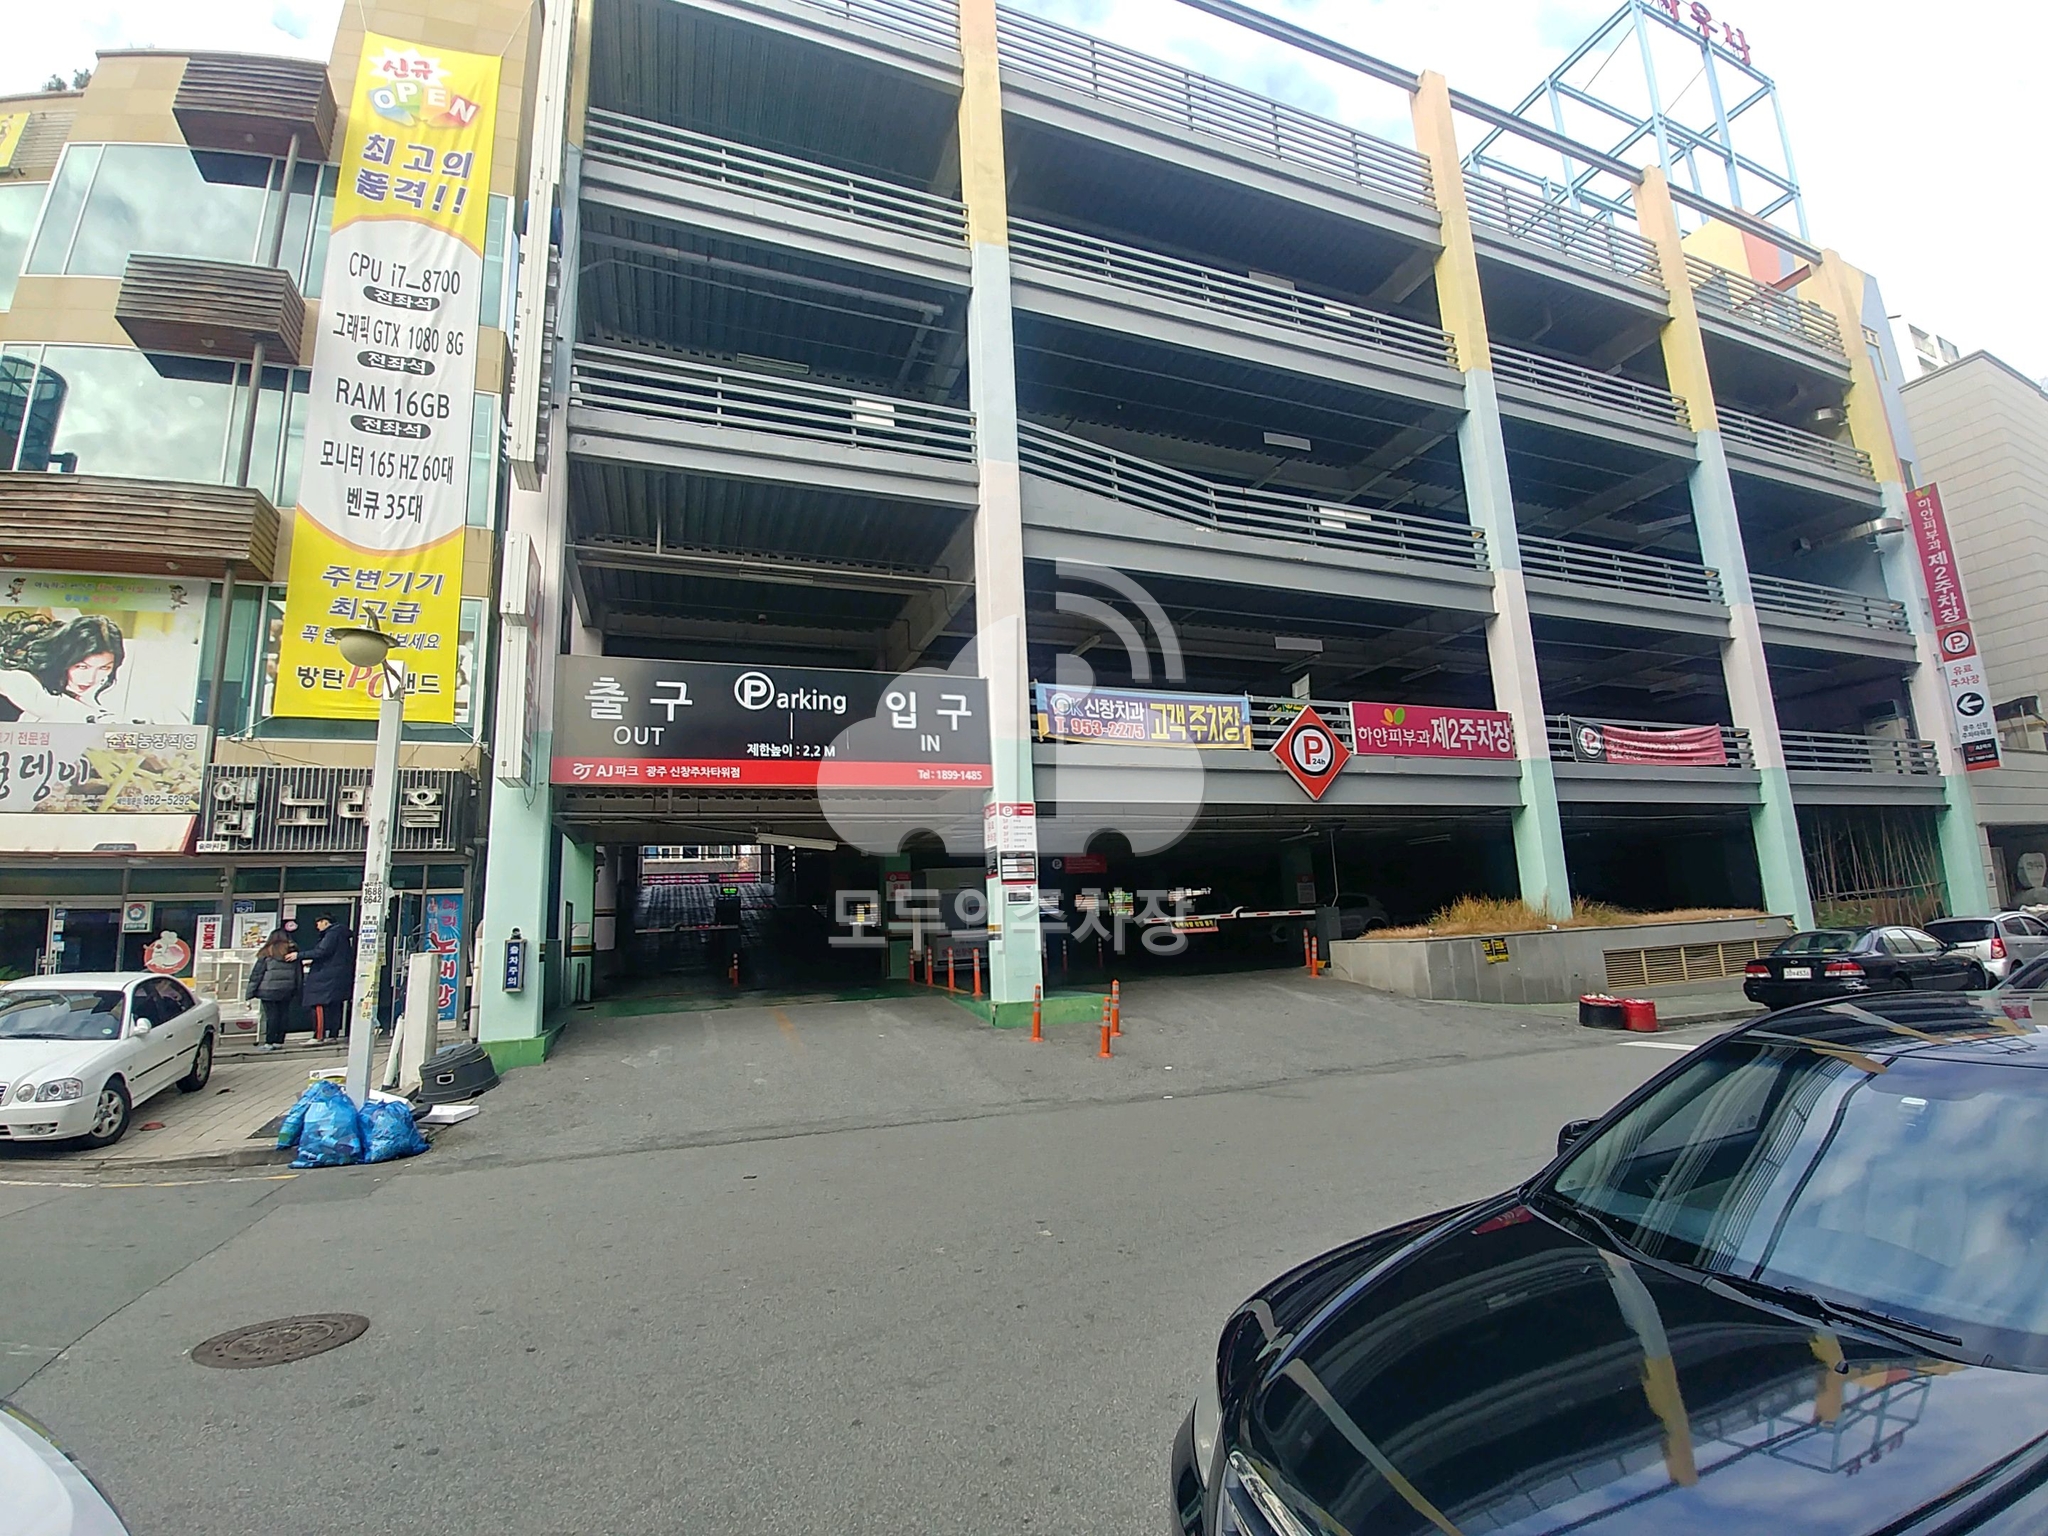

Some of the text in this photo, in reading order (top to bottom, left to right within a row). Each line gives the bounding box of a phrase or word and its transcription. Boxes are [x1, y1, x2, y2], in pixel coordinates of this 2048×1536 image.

[383, 57, 434, 80] 신규
[372, 82, 481, 123] OPEN
[362, 133, 473, 179] 최고의
[355, 168, 468, 215] 품격!!
[349, 252, 383, 282] CPU
[373, 288, 433, 311] 전좌석
[333, 312, 464, 356] 그래픽 GTX 1080 8G
[367, 353, 427, 376] 전좌석
[335, 378, 451, 419] RAM 16GB
[362, 417, 422, 438] 전좌석
[320, 440, 454, 485] 모니터 165 HZ 60대
[346, 487, 424, 523] 벤큐 35대
[1917, 497, 1942, 551] 하얀피부과
[322, 564, 444, 596] 주변기기
[1928, 551, 1960, 624] 제2주차장
[329, 596, 421, 624] 최고급
[301, 625, 319, 644] 꼭
[388, 630, 440, 651] 보세요
[1951, 674, 1980, 687] 주차장
[1953, 664, 1973, 676] 유료
[585, 671, 972, 731] 출구 Parking 입구
[1084, 698, 1145, 721] 신창치과
[1055, 716, 1146, 740] T. 953-2275
[1150, 703, 1241, 742] 고객 주차장
[1357, 716, 1511, 753] 하얀피부과 제2주차장
[18, 732, 50, 746] 전문점
[107, 732, 198, 751] 순천농장직영
[613, 726, 940, 753] OUT IN
[746, 743, 793, 758] 제한높이
[824, 745, 836, 757] M
[1303, 735, 1324, 765] P
[646, 766, 668, 778] 광주
[669, 767, 741, 779] 신창주차타워점
[364, 887, 383, 896] 1688
